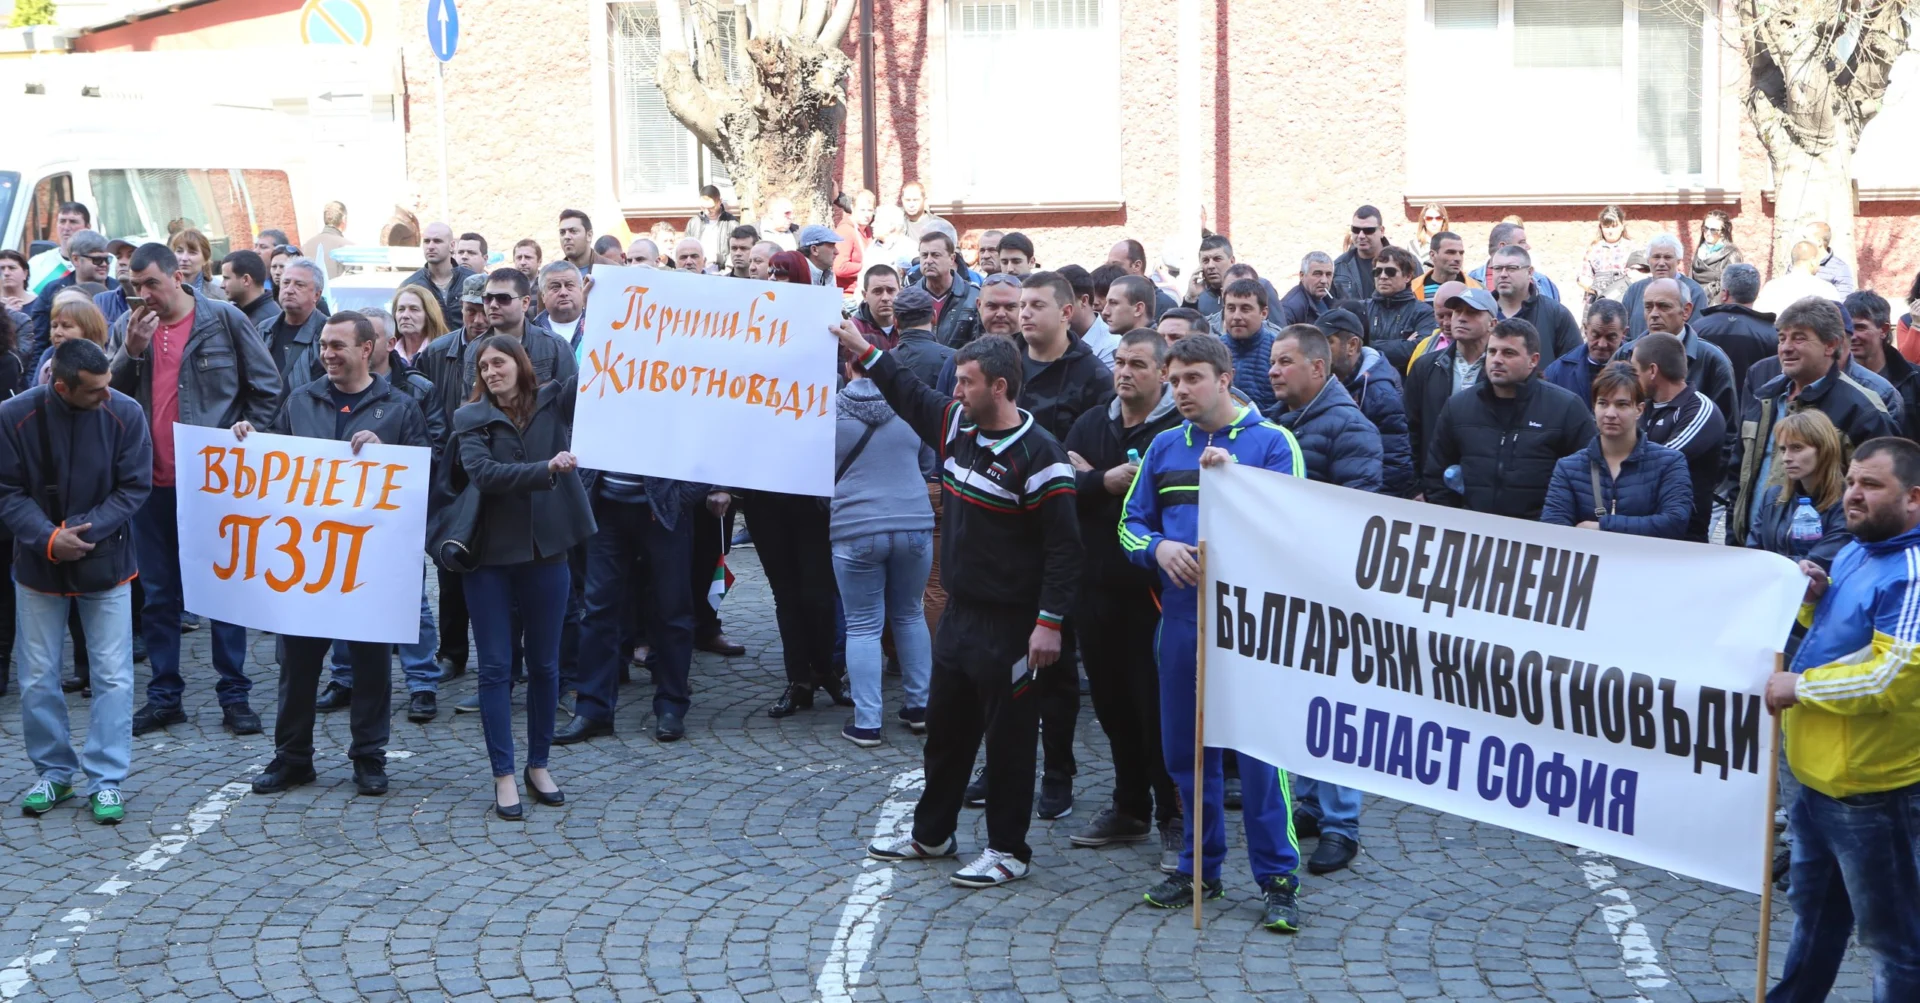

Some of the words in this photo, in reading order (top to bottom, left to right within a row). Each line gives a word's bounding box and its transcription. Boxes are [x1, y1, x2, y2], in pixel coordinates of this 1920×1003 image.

[198, 444, 408, 511] ВЪРНЕТЕ
[213, 513, 373, 594] ПЗП
[1355, 514, 1599, 630] ОБЕДИНЕНИ
[1215, 580, 1422, 696] БЪЛГАРСКИ
[1428, 631, 1761, 781] ЖИВОТНОВЪДИ
[1306, 696, 1470, 791] ОБЛАСТ
[1476, 735, 1638, 836] СОФИЯ
